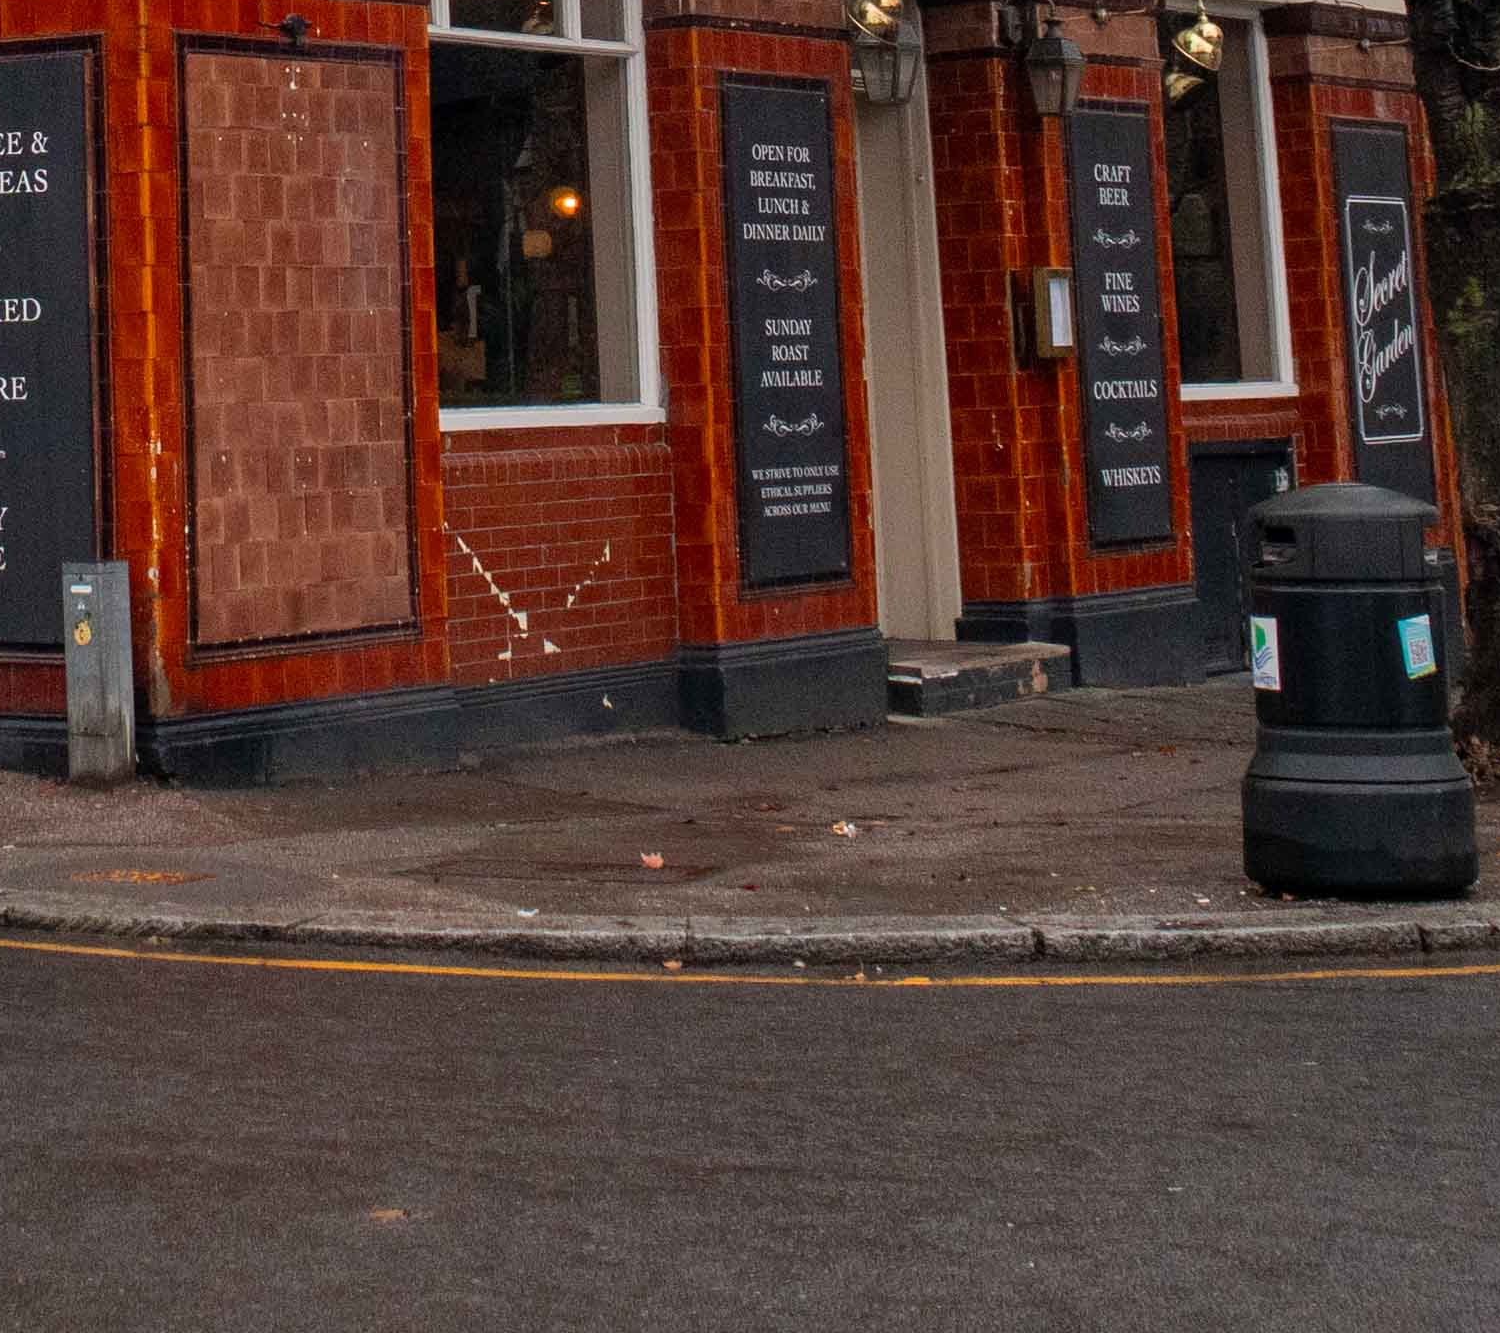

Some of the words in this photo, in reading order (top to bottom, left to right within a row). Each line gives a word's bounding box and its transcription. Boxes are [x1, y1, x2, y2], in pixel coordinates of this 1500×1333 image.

[30, 131, 49, 152] &
[751, 143, 784, 161] OPEN
[786, 145, 811, 163] FOR
[749, 170, 816, 190] BREAKFAST,
[1093, 163, 1132, 183] CRAFT
[758, 196, 799, 215] LUNCH
[801, 199, 810, 215] &
[1098, 187, 1130, 206] BEER
[743, 223, 791, 241] DINNER
[792, 224, 826, 242] DAILY
[1104, 272, 1134, 291] FINE
[1354, 250, 1408, 326] Secret
[1100, 294, 1140, 313] WINES
[765, 318, 812, 337] SUNDAY
[771, 344, 810, 362] ROAST
[1358, 319, 1414, 403] Garden
[760, 369, 823, 388] AVAILABLE
[1093, 379, 1158, 400] COCKTAILS
[792, 466, 803, 478] TO
[1101, 465, 1161, 487] WHISKEYS
